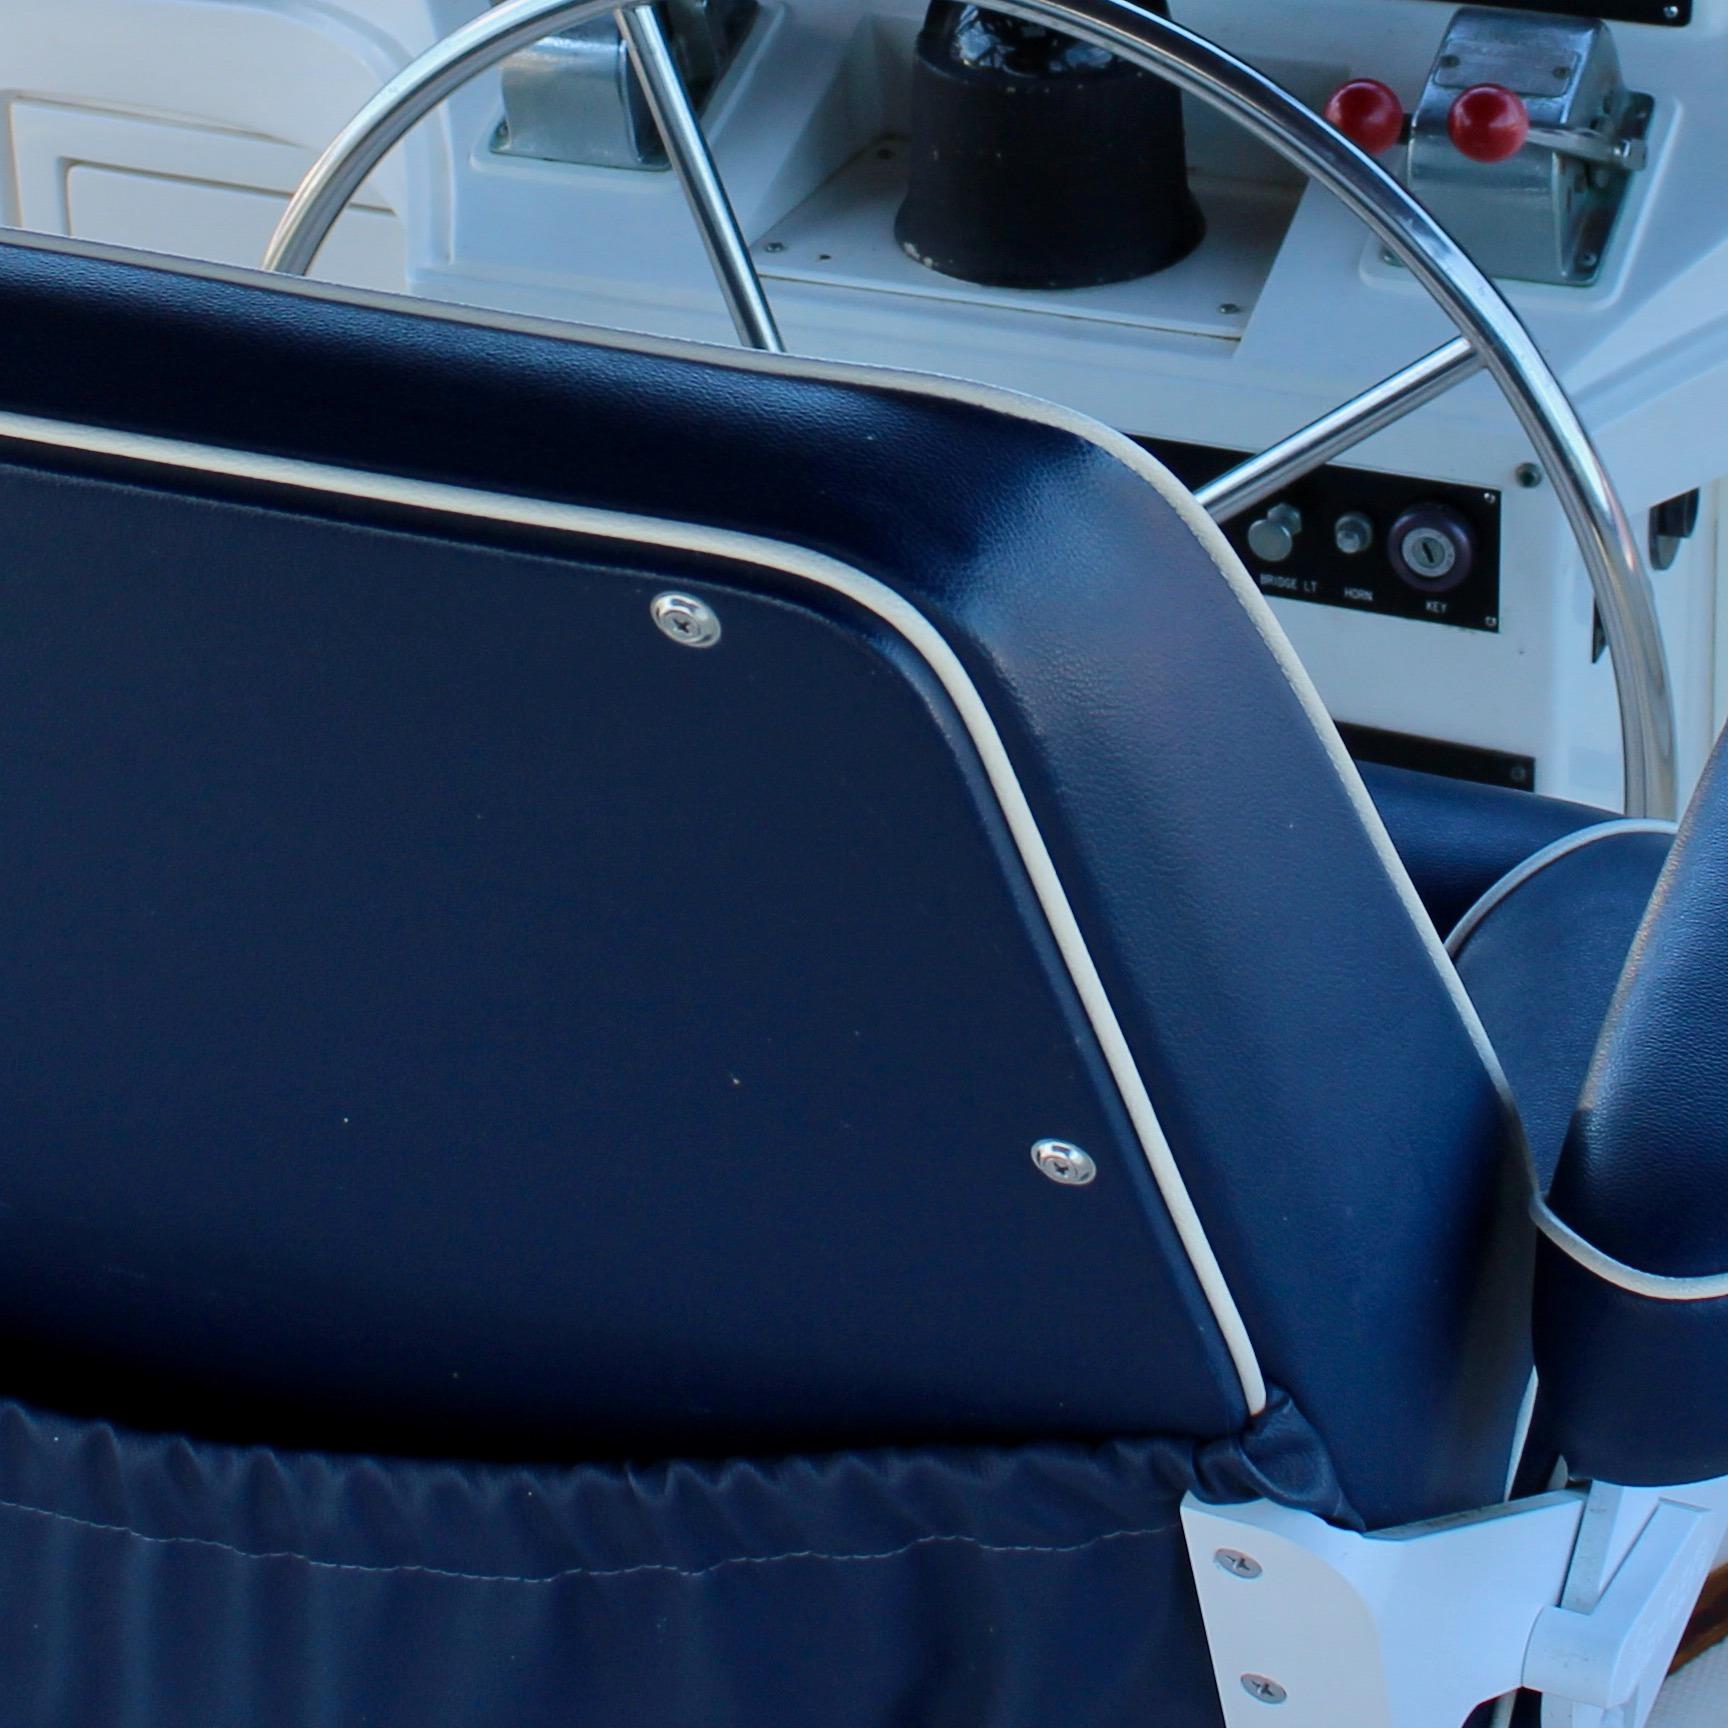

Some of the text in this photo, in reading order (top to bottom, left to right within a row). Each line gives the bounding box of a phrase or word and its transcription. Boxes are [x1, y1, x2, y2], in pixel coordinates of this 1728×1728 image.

[1260, 573, 1318, 593] BRIDGE LT
[1343, 587, 1373, 602] HORN
[1425, 600, 1447, 613] KEY
